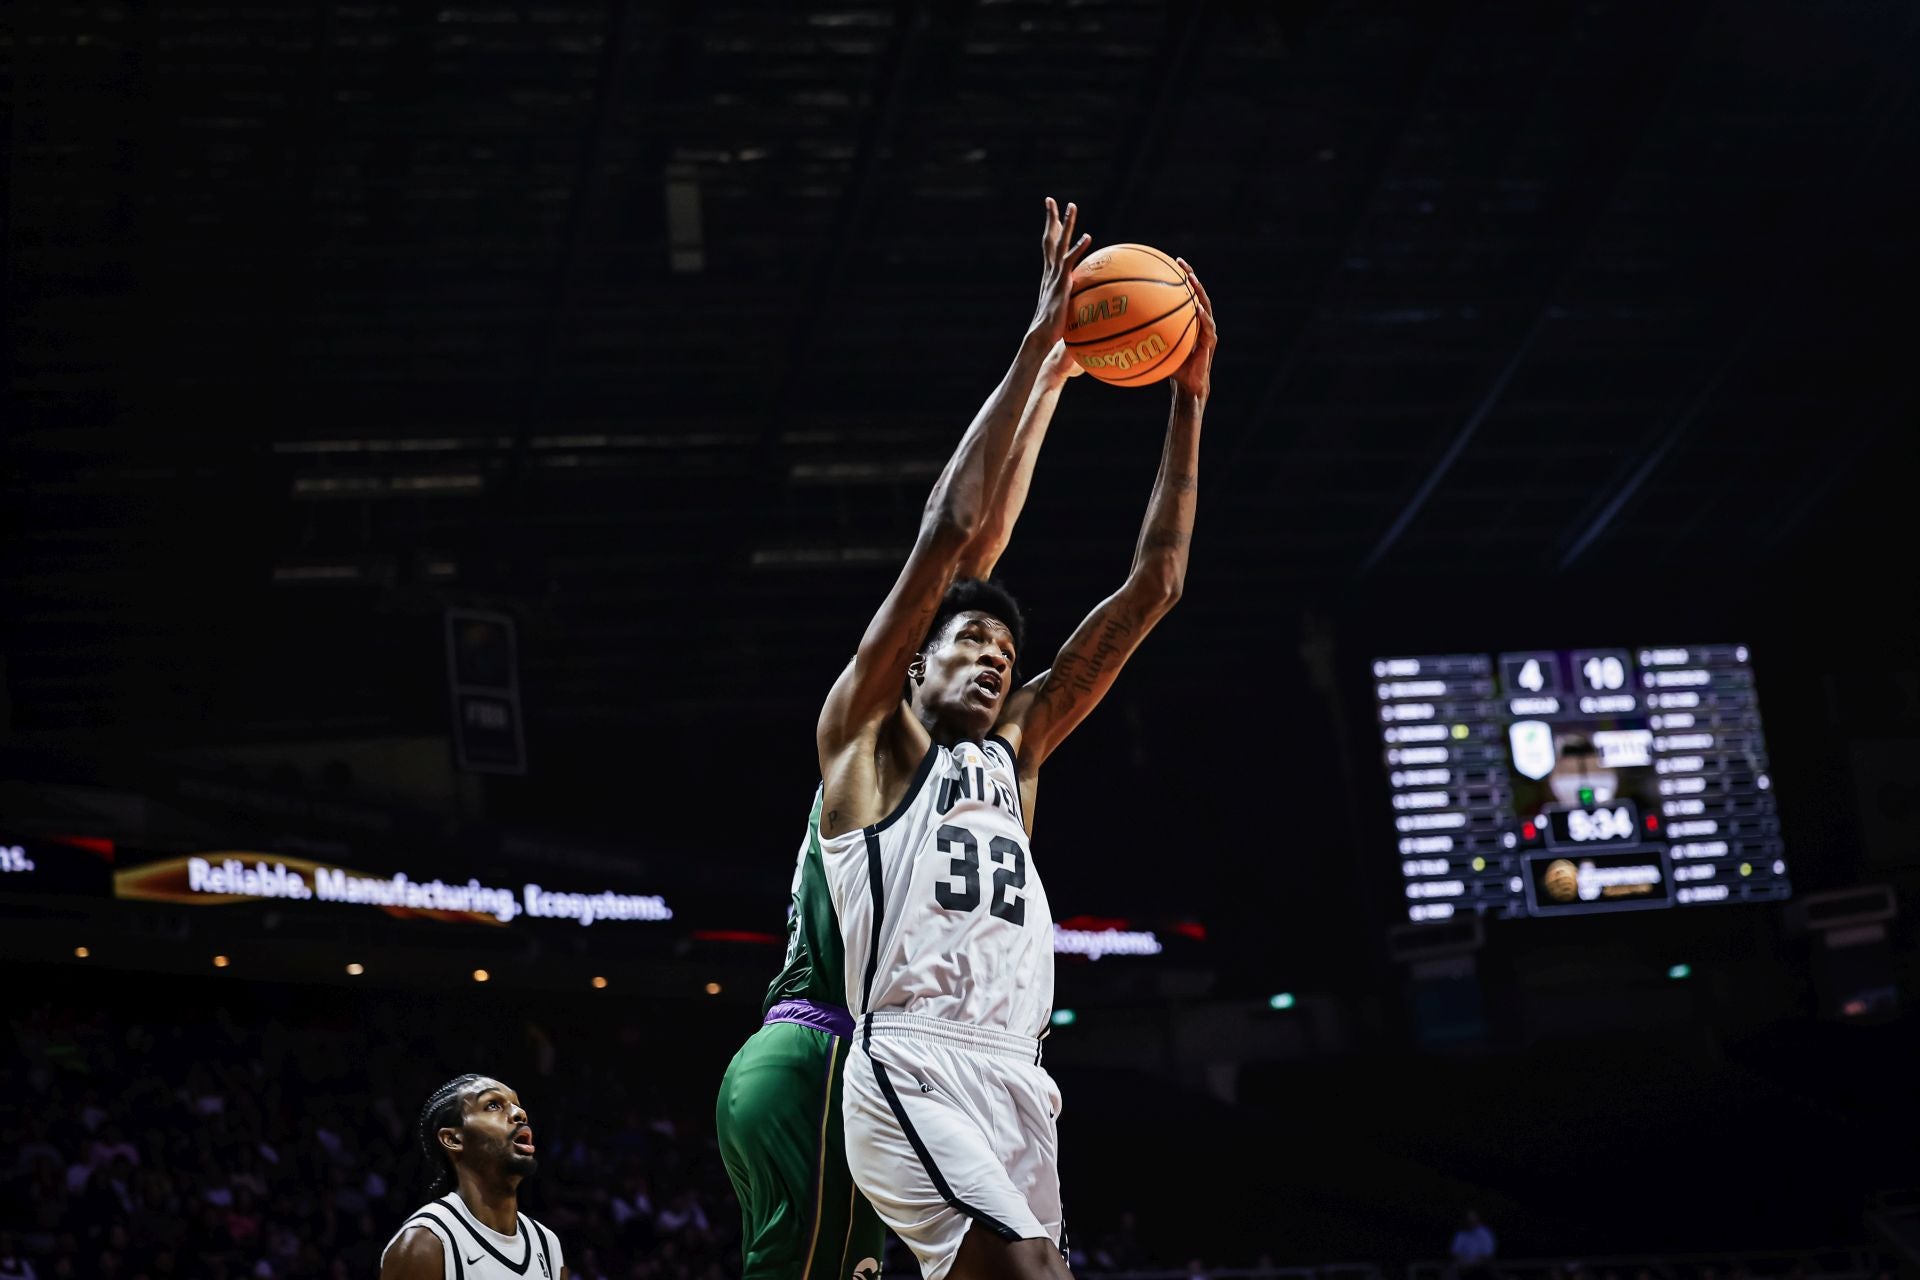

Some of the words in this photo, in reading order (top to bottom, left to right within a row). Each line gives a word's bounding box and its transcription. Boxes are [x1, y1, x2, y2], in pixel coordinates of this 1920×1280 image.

[1081, 333, 1168, 370] Wilson
[1518, 659, 1543, 692] 4
[1584, 657, 1624, 690] 10
[187, 858, 312, 899] Reliable.
[315, 868, 522, 922] Manufacturing.
[523, 884, 672, 925] Ecosystems.
[935, 824, 1026, 927] 32
